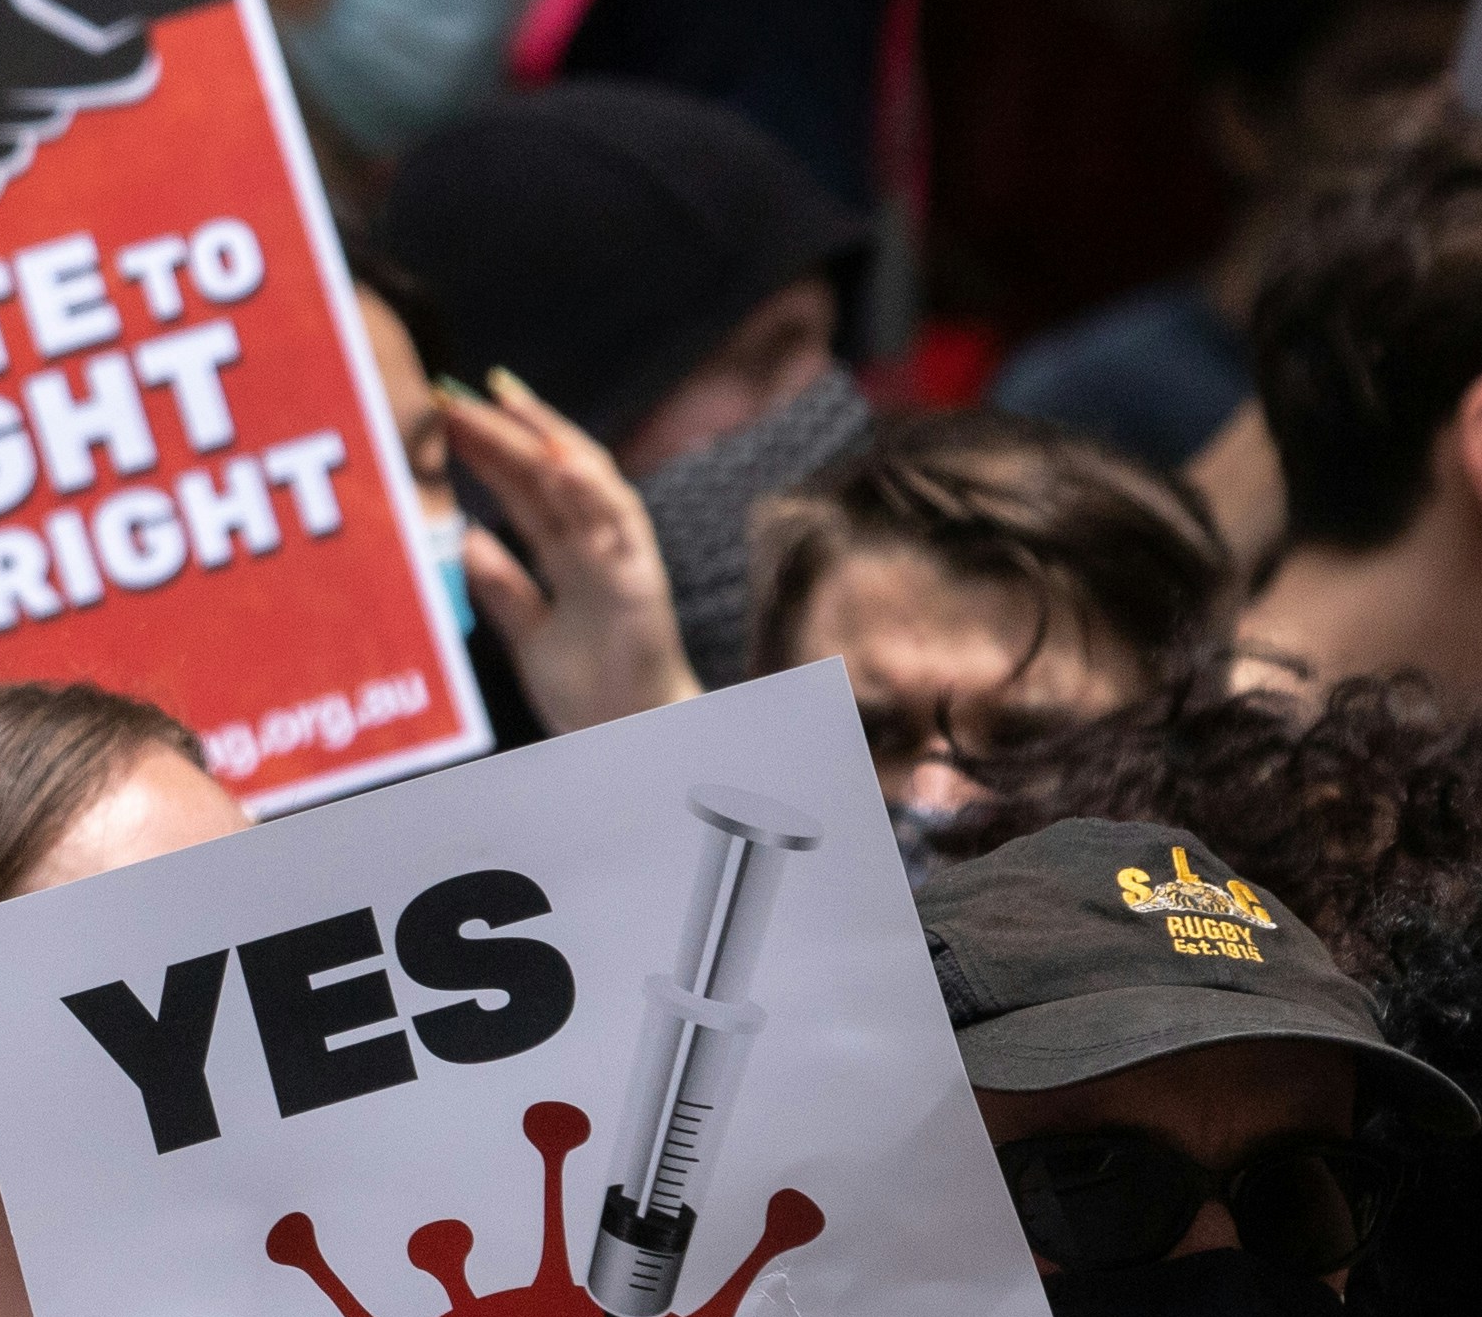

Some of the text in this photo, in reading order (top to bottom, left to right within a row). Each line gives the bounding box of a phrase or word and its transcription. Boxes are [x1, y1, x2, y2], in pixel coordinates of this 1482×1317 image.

[121, 218, 264, 320] TO
[1166, 915, 1255, 946] RUGBY
[1174, 938, 1265, 963] Est.1915
[61, 869, 576, 1155] YES
